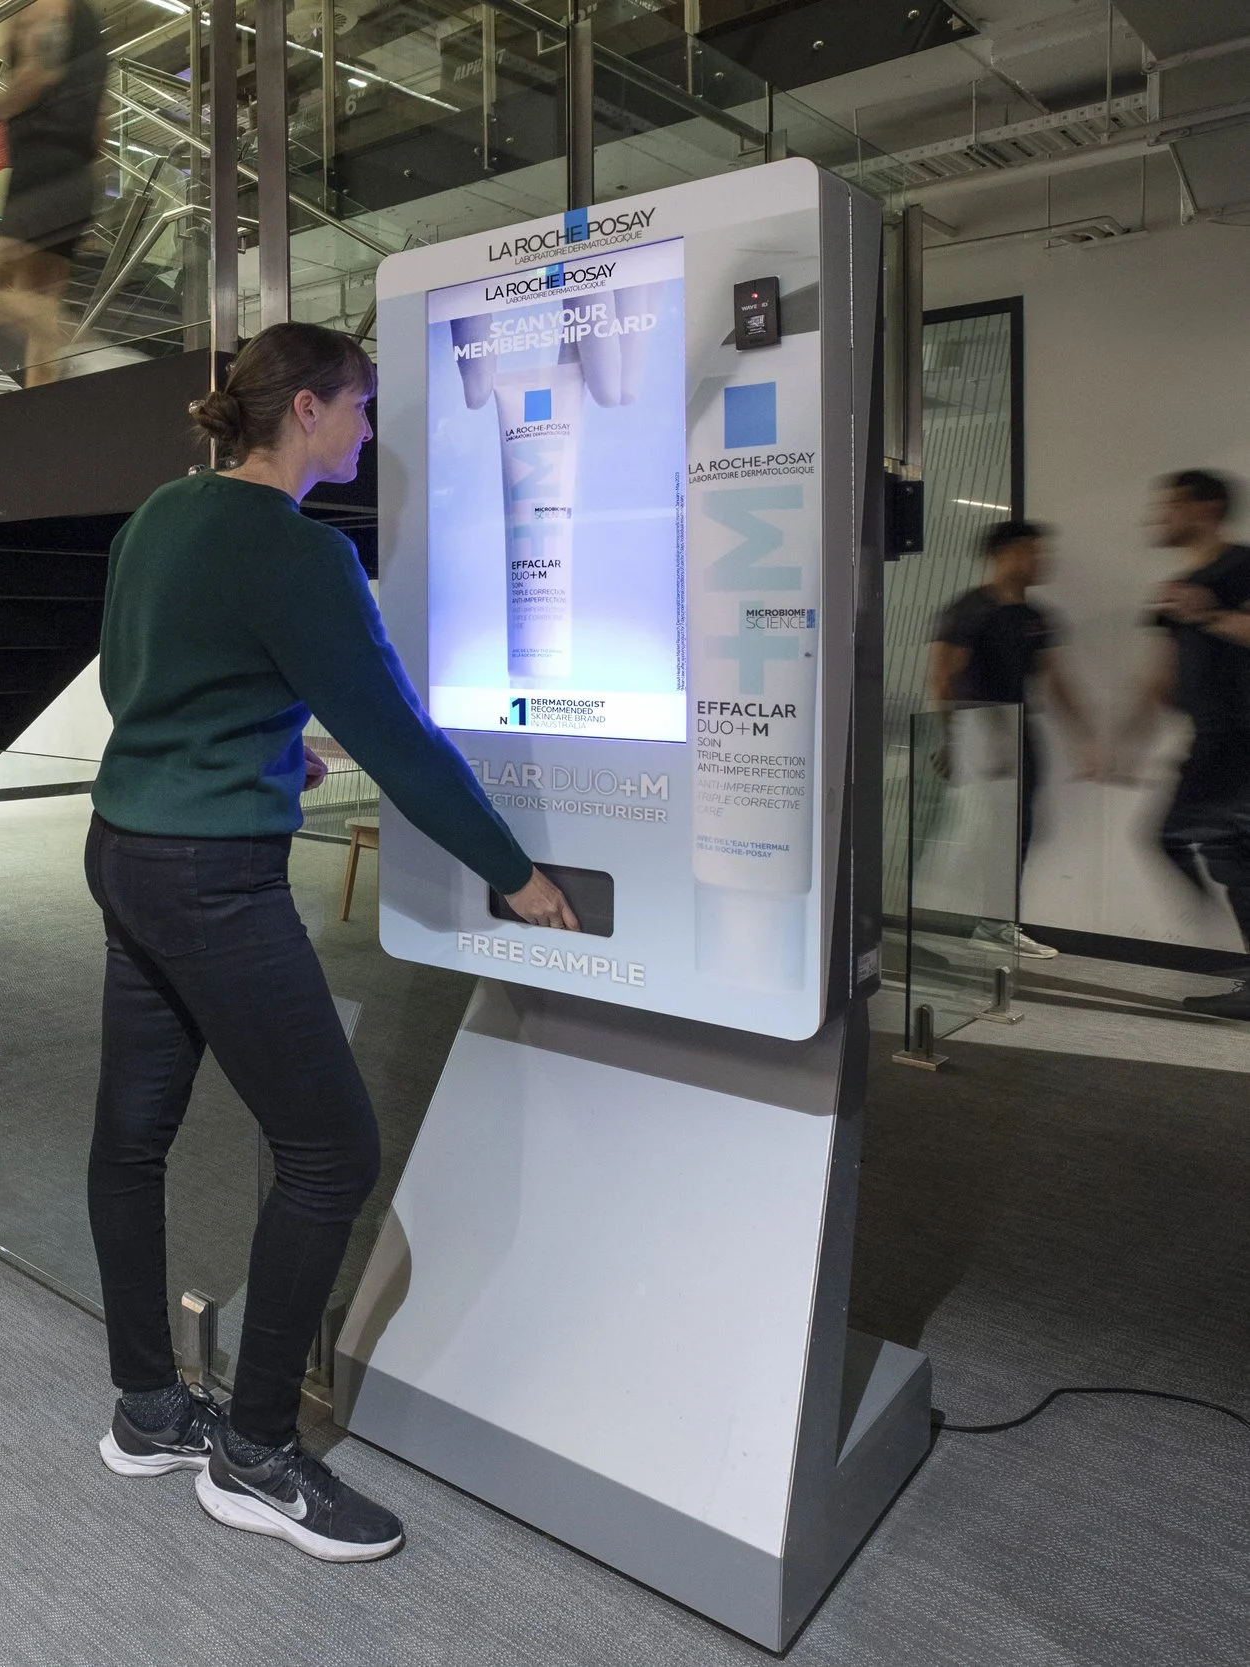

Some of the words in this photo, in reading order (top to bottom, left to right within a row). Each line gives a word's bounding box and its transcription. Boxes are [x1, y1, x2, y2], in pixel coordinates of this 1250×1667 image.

[488, 242, 512, 262] LA
[515, 224, 582, 256] ROCHE
[587, 207, 656, 240] POSAY
[514, 248, 568, 265] LABORATOIRE
[568, 230, 642, 254] DERMATOLOGIQUE
[486, 287, 504, 301] LA
[507, 274, 560, 296] ROCHE
[563, 262, 616, 286] POSAY
[506, 290, 548, 304] LABORATOIRE
[548, 280, 606, 296] DERMATOLOGIQUE
[490, 314, 544, 338] SCAN
[547, 303, 608, 328] YOUR
[453, 325, 592, 362] MEMBERSHIP
[594, 313, 657, 338] CARD
[516, 424, 570, 434] ROCHE-POSAY
[689, 462, 704, 474] LA
[710, 452, 815, 471] ROCHE-POSAY
[689, 471, 738, 484] LABORATOIRE
[741, 466, 814, 478] DERMATOLOGIQUE
[512, 560, 561, 570] EFFACLAR
[512, 570, 547, 581] DUO+M
[746, 617, 805, 629] SCIENCE
[531, 698, 606, 708] DERMATOLOGIST
[531, 706, 593, 714] RECOMMENDED
[698, 701, 796, 718] EFFACLAR
[531, 713, 572, 722] SKINCARE
[539, 720, 586, 729] AUSTRALIA
[698, 719, 768, 736] DUO+M
[698, 737, 721, 747] SOIN
[697, 750, 731, 762] TRIPLE
[734, 754, 805, 766] CORRECTION
[698, 763, 805, 779] ANTI-IMPERFECTIONS
[552, 766, 669, 800] DUO+M
[698, 780, 805, 796] ANTI-IMPERFECTIONS
[698, 792, 731, 804] TRIPLE
[734, 796, 800, 809] CORRECTIVE
[552, 799, 668, 823] MOISTURISER
[697, 805, 723, 816] CARE
[715, 845, 772, 858] ROCHE-POSAY
[725, 839, 748, 848] L'EAU
[750, 842, 790, 851] THERMALE
[457, 932, 524, 963] FREE
[530, 945, 646, 987] SAMPLE
